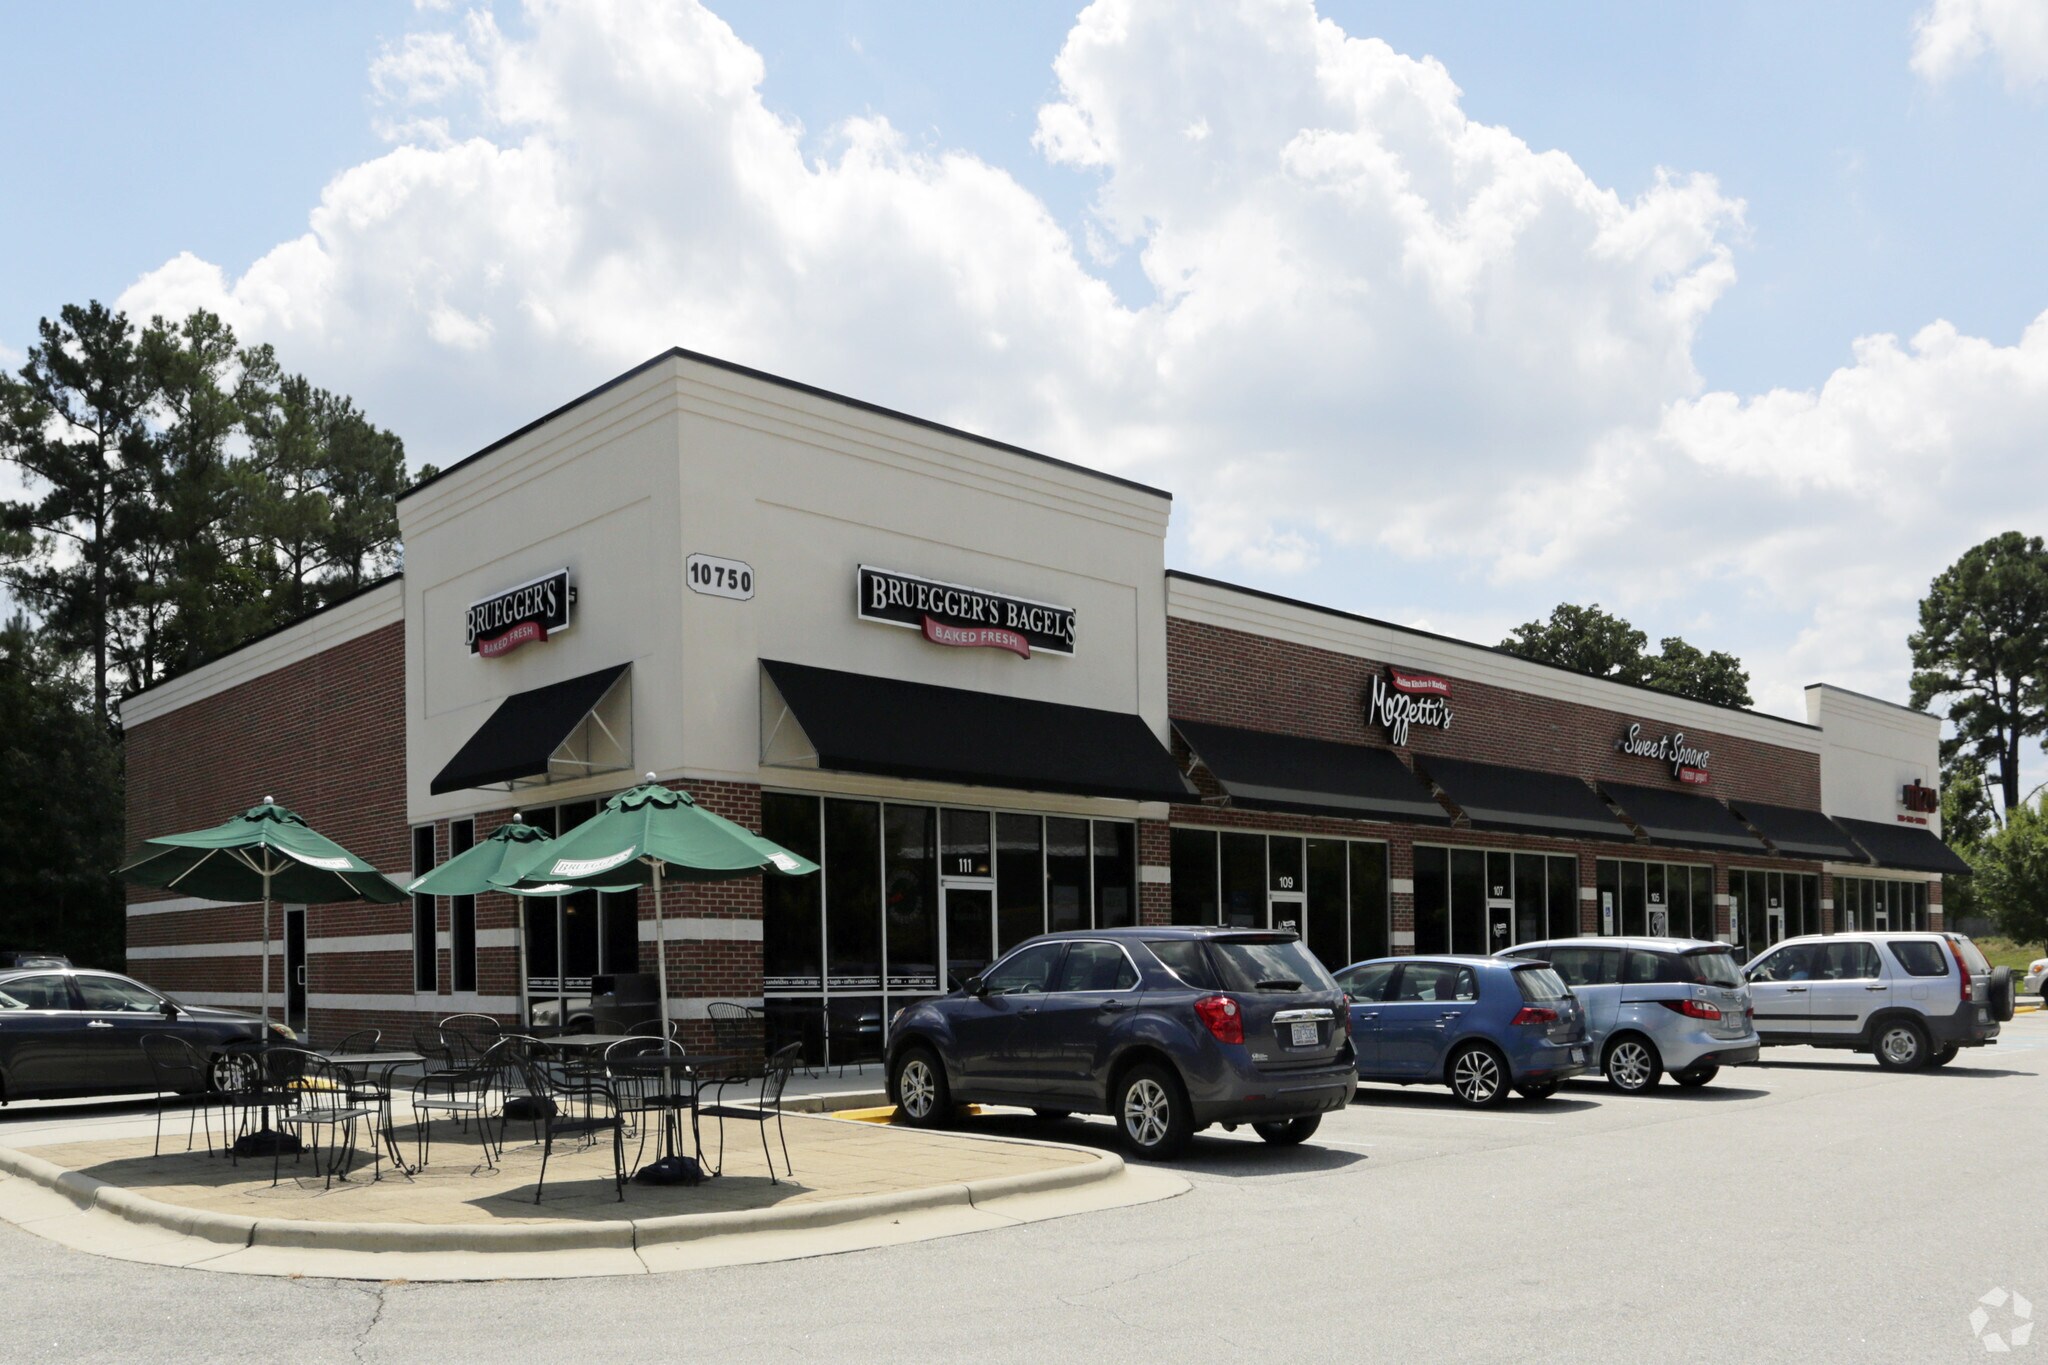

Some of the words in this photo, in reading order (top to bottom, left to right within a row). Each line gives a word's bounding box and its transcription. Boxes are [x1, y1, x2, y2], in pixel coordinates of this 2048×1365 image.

[690, 562, 751, 592] 10750
[464, 579, 557, 646] BRUEGGER'S
[870, 574, 999, 625] BRUEGGER'S
[1006, 602, 1077, 646] BAGELS
[483, 636, 508, 654] BAKED
[509, 625, 534, 642] FRESH
[935, 626, 977, 643] BAKED
[980, 631, 1018, 647] FRESH
[1369, 674, 1454, 747] Mozzetti's
[1624, 723, 1668, 760] Sweet
[1669, 732, 1710, 777] Spoons
[959, 858, 972, 873] 111
[1279, 876, 1294, 888] 109
[1493, 885, 1504, 896] 107
